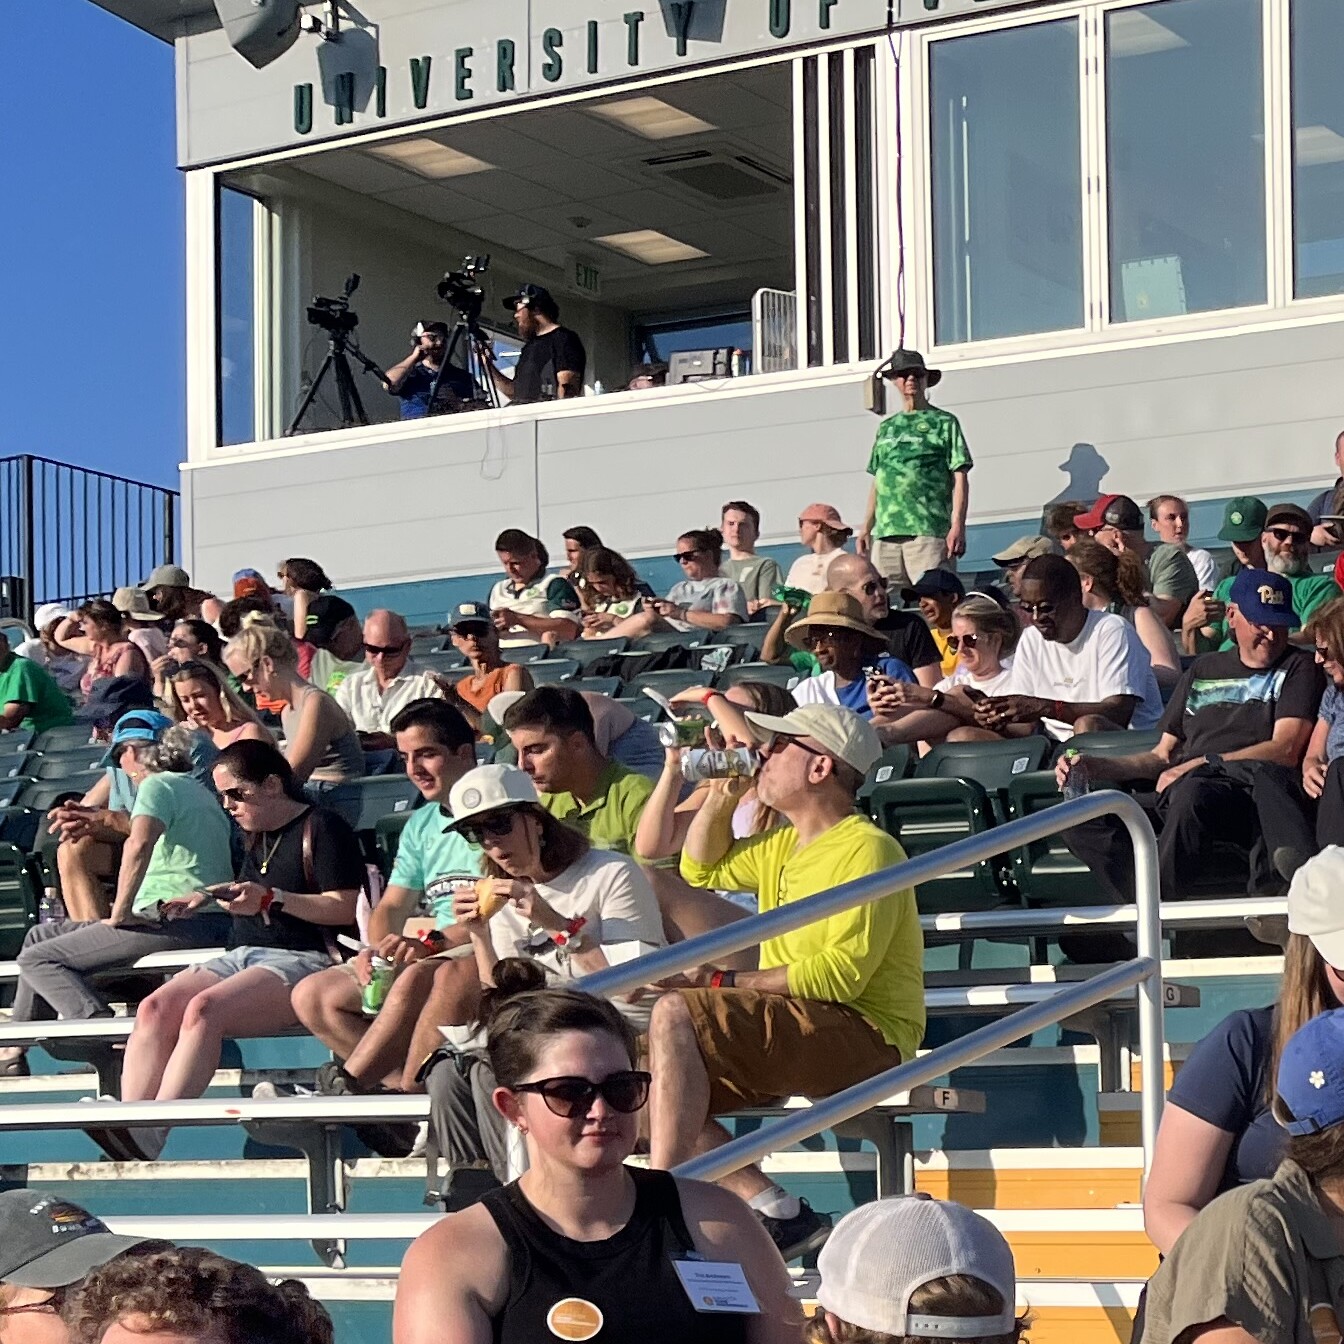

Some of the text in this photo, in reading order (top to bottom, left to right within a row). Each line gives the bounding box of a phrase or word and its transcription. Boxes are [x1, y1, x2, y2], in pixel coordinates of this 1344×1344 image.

[294, 0, 693, 135] UNIVERSITY
[575, 262, 600, 293] EXIT
[1166, 987, 1175, 1001] G
